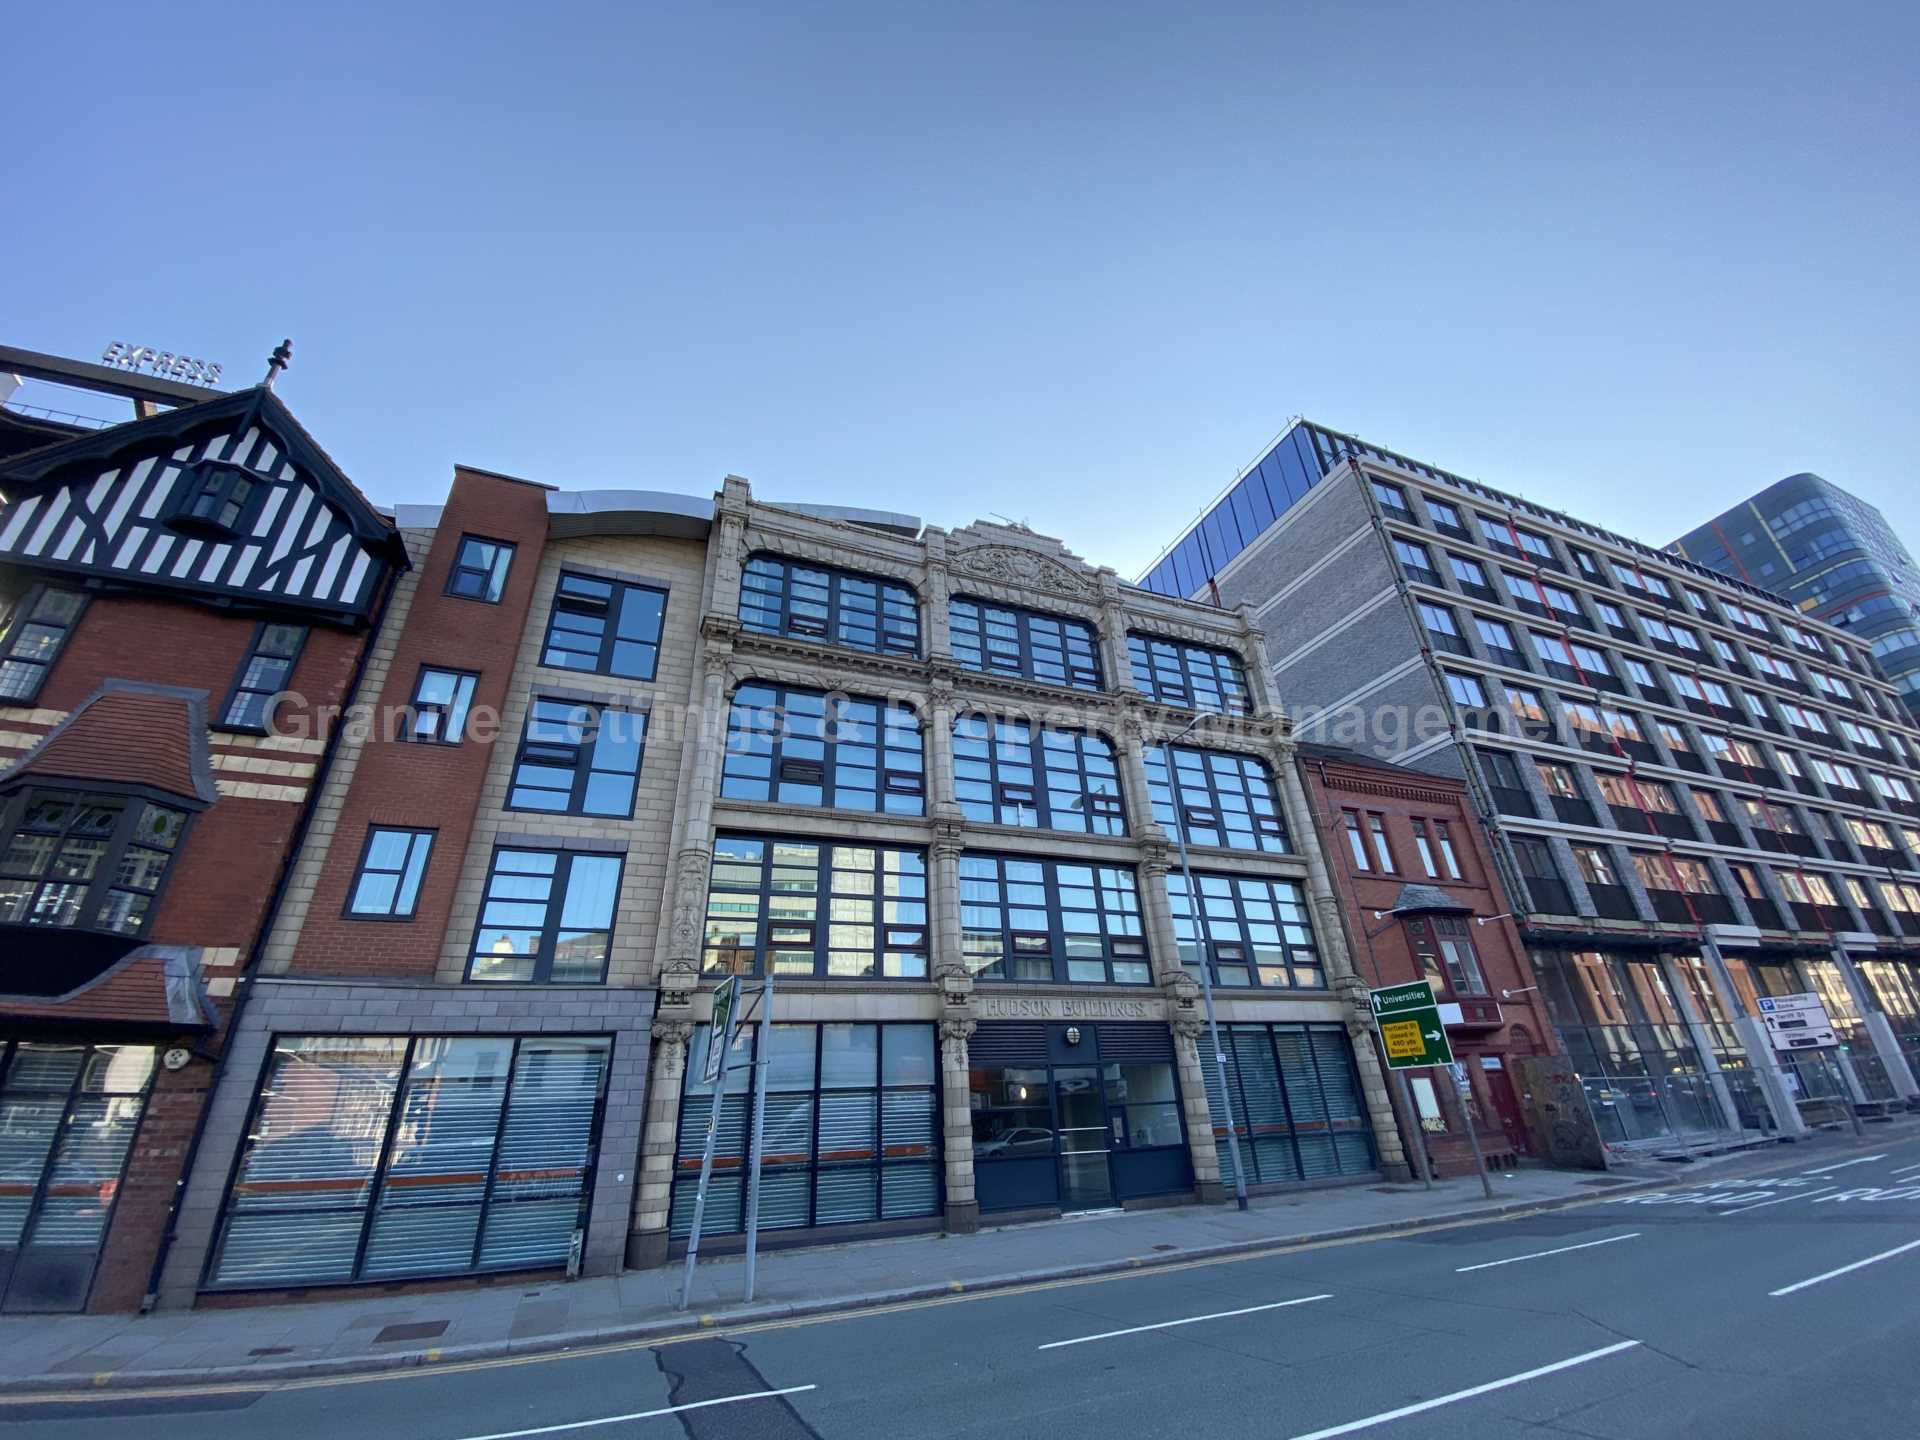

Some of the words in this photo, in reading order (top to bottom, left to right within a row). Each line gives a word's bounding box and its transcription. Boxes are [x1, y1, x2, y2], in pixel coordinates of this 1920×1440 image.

[102, 341, 223, 384] EXPRESS
[1382, 991, 1426, 1004] Universities
[986, 999, 1052, 1018] HUDSON
[1062, 999, 1148, 1018] BUILDINGS
[1601, 1191, 1776, 1205] ROAD
